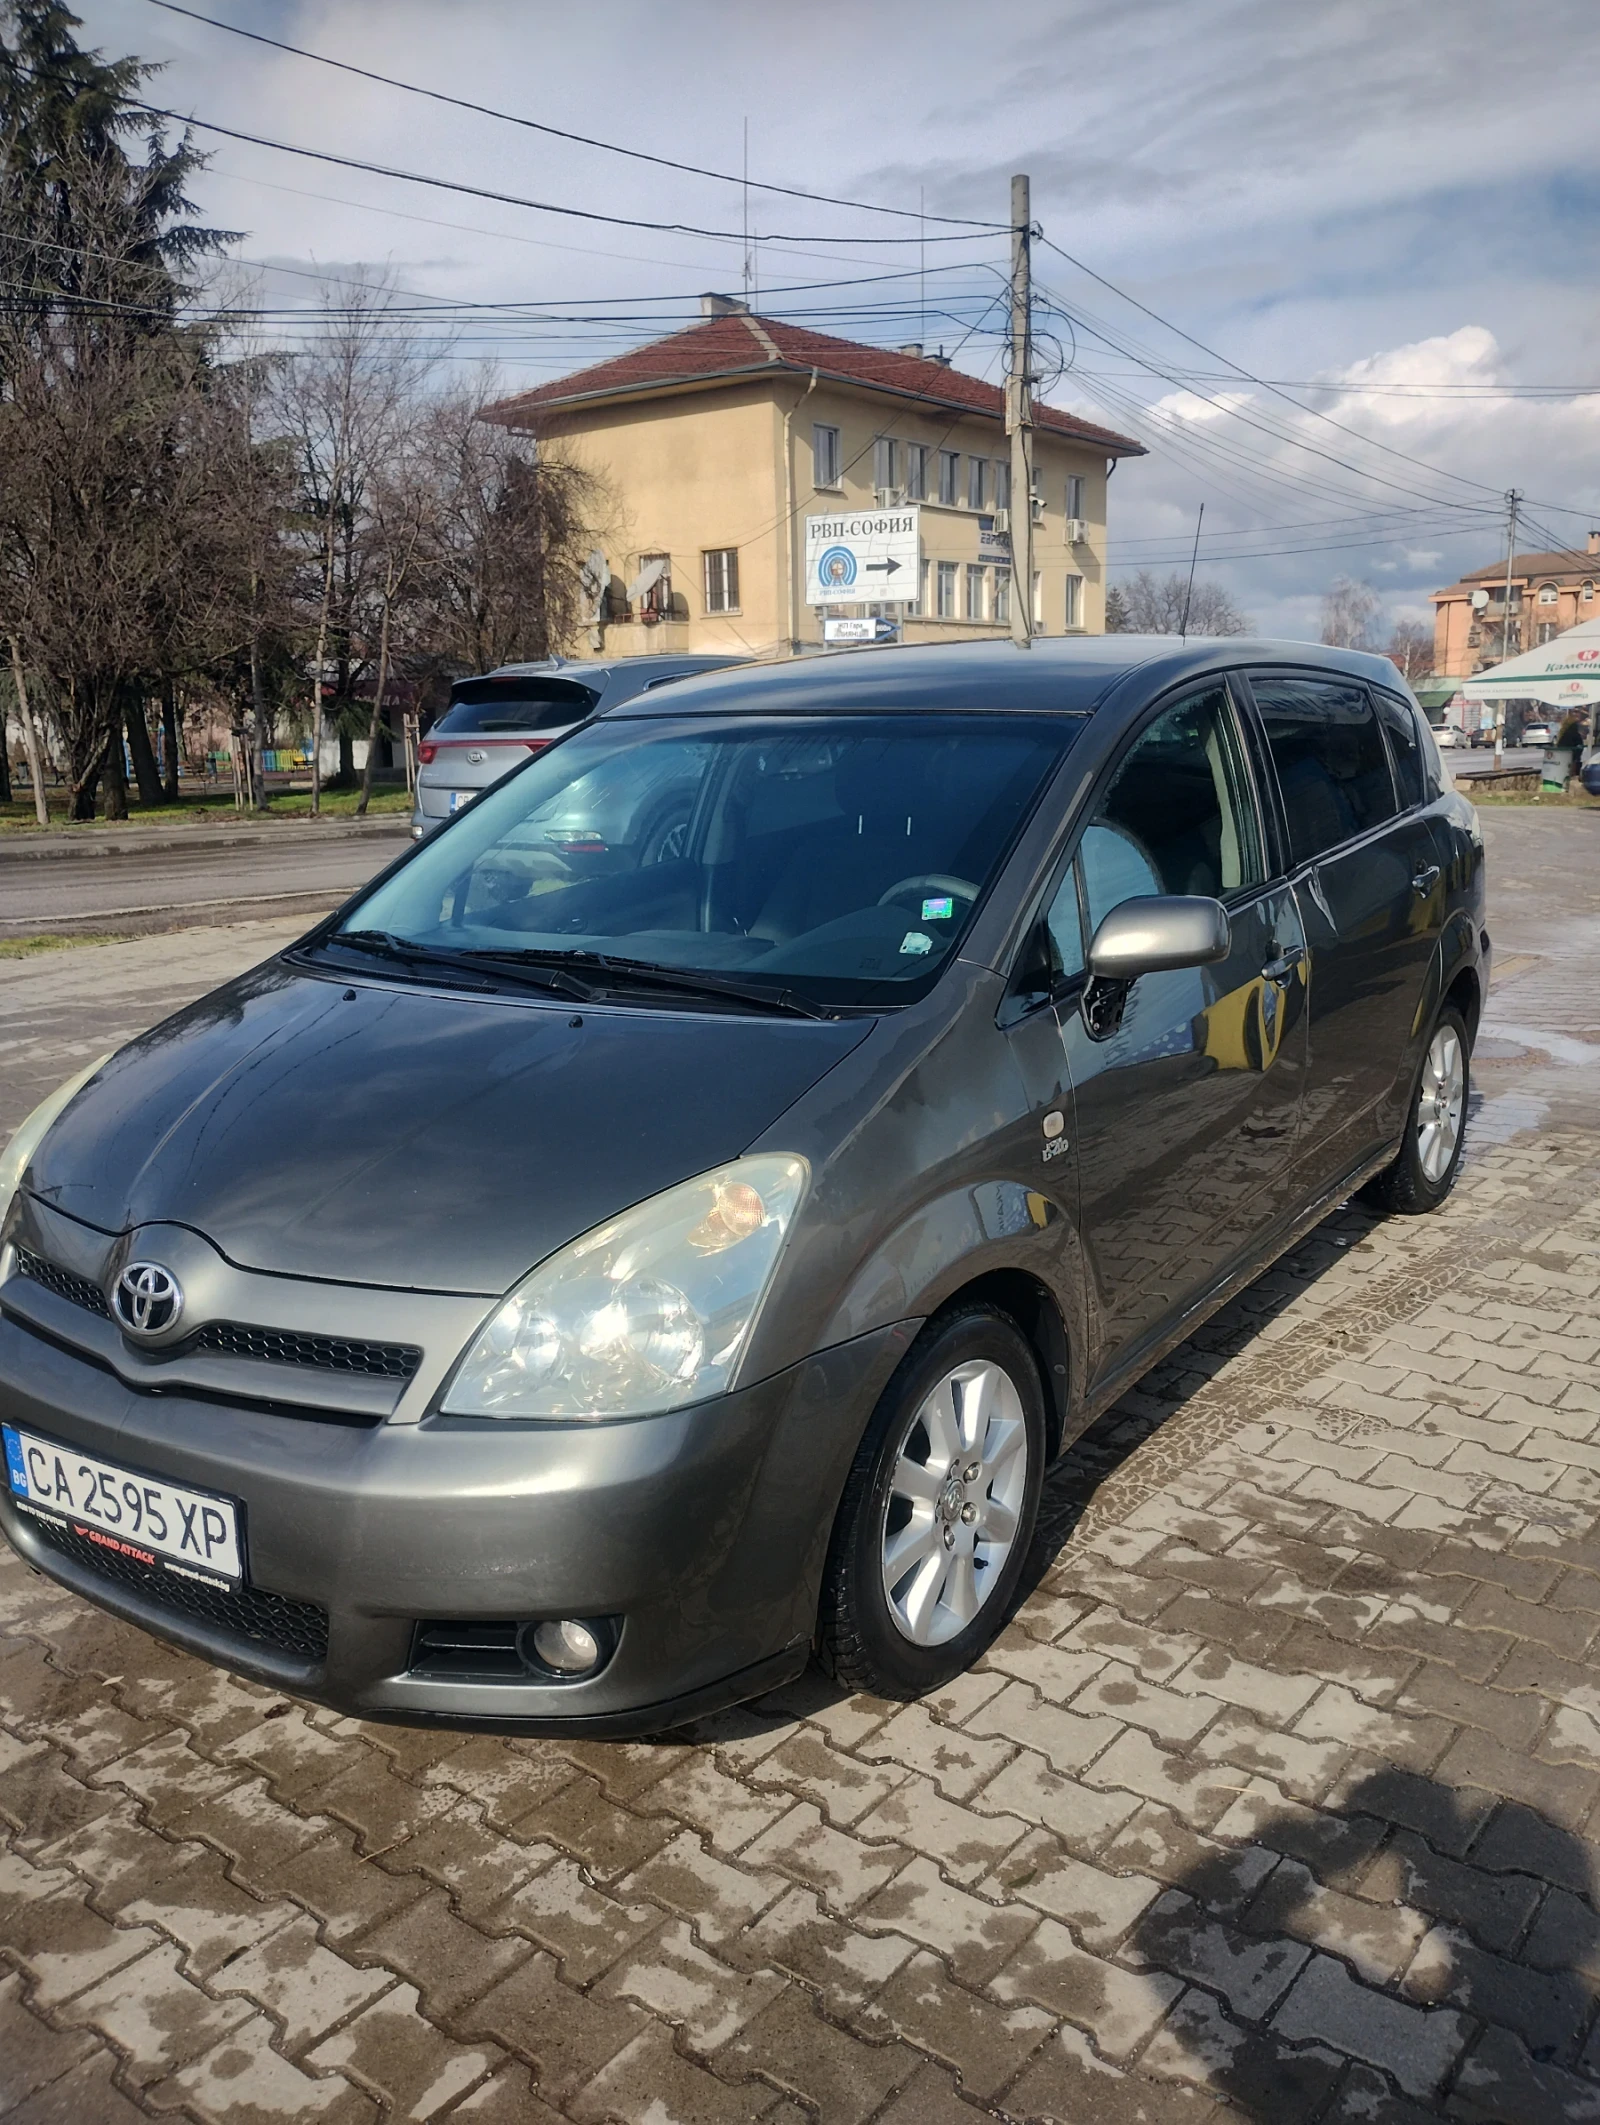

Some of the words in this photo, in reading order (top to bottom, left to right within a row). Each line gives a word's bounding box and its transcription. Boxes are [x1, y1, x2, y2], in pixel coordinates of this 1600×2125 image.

[811, 517, 914, 539] РВП-СОФИЯ
[12, 1469, 27, 1488] BG
[28, 1447, 75, 1507] CA
[78, 1466, 168, 1541] 2595
[175, 1497, 227, 1559] XP
[89, 1530, 120, 1551] GRAND
[120, 1543, 155, 1565] ATTACK
